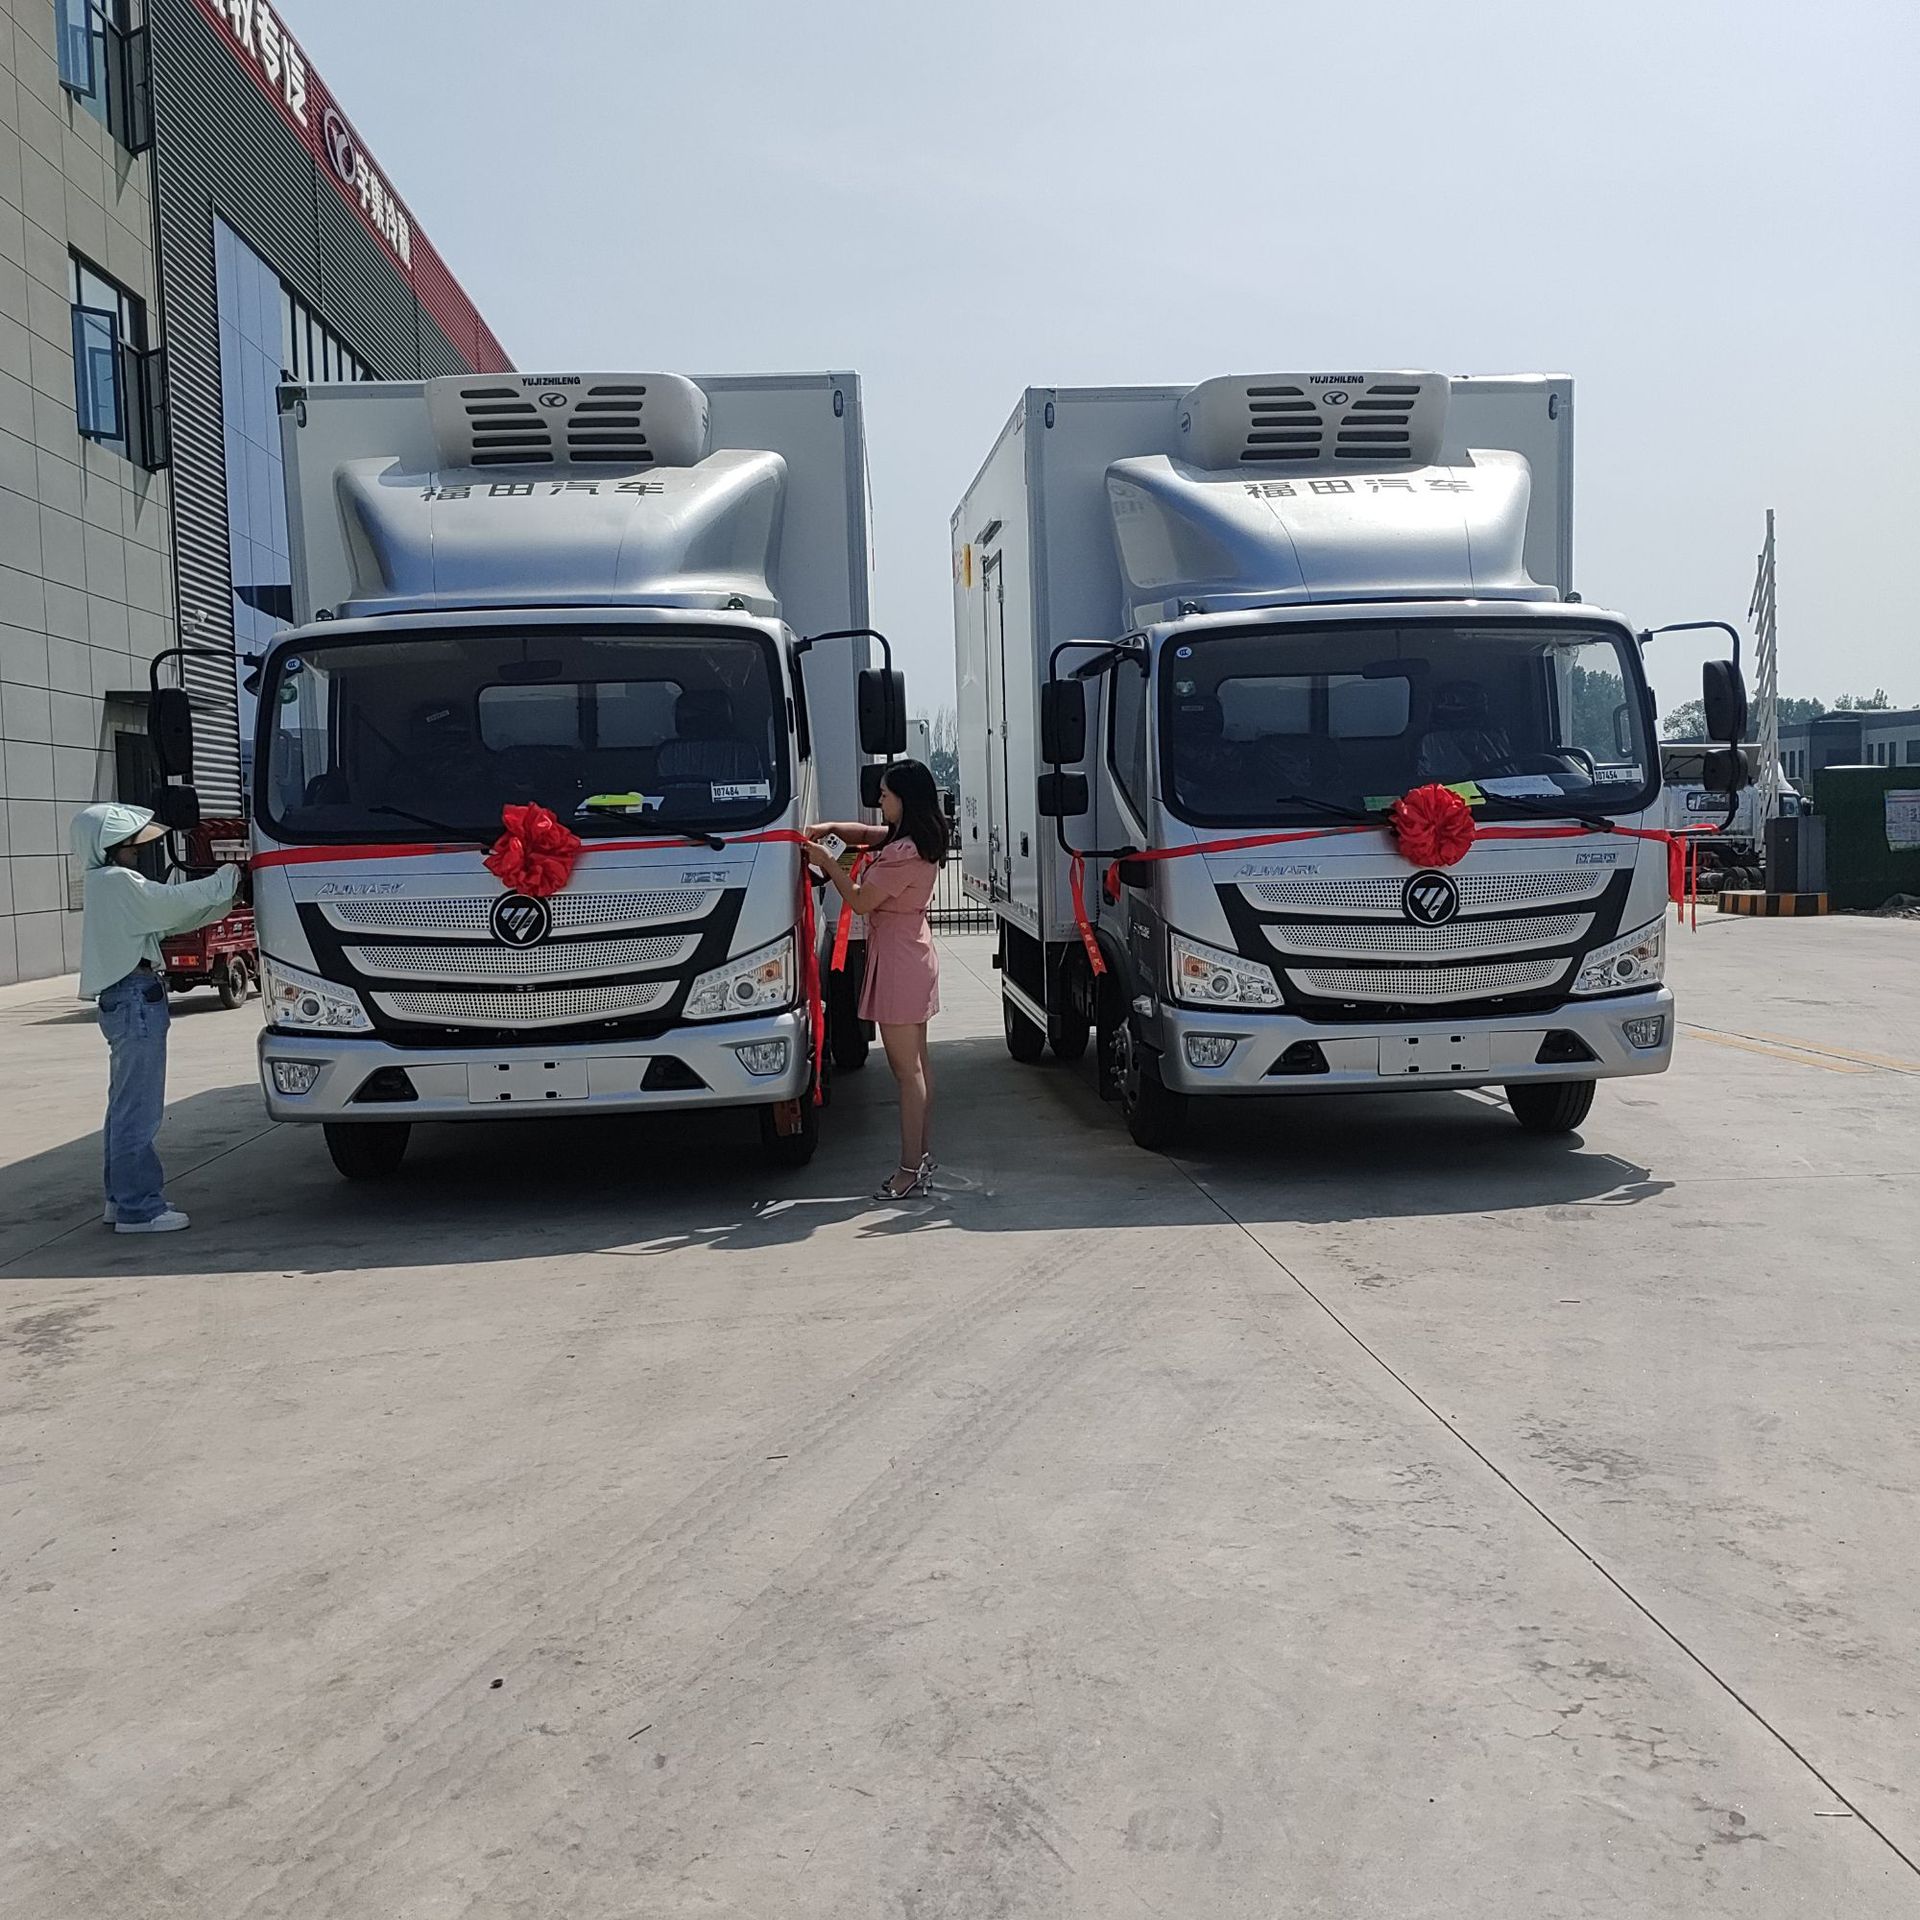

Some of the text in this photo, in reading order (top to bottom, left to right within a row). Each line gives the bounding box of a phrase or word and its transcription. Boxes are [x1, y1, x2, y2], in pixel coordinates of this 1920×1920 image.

[419, 481, 665, 502] 福田汽车
[1243, 478, 1474, 499] 福田汽车
